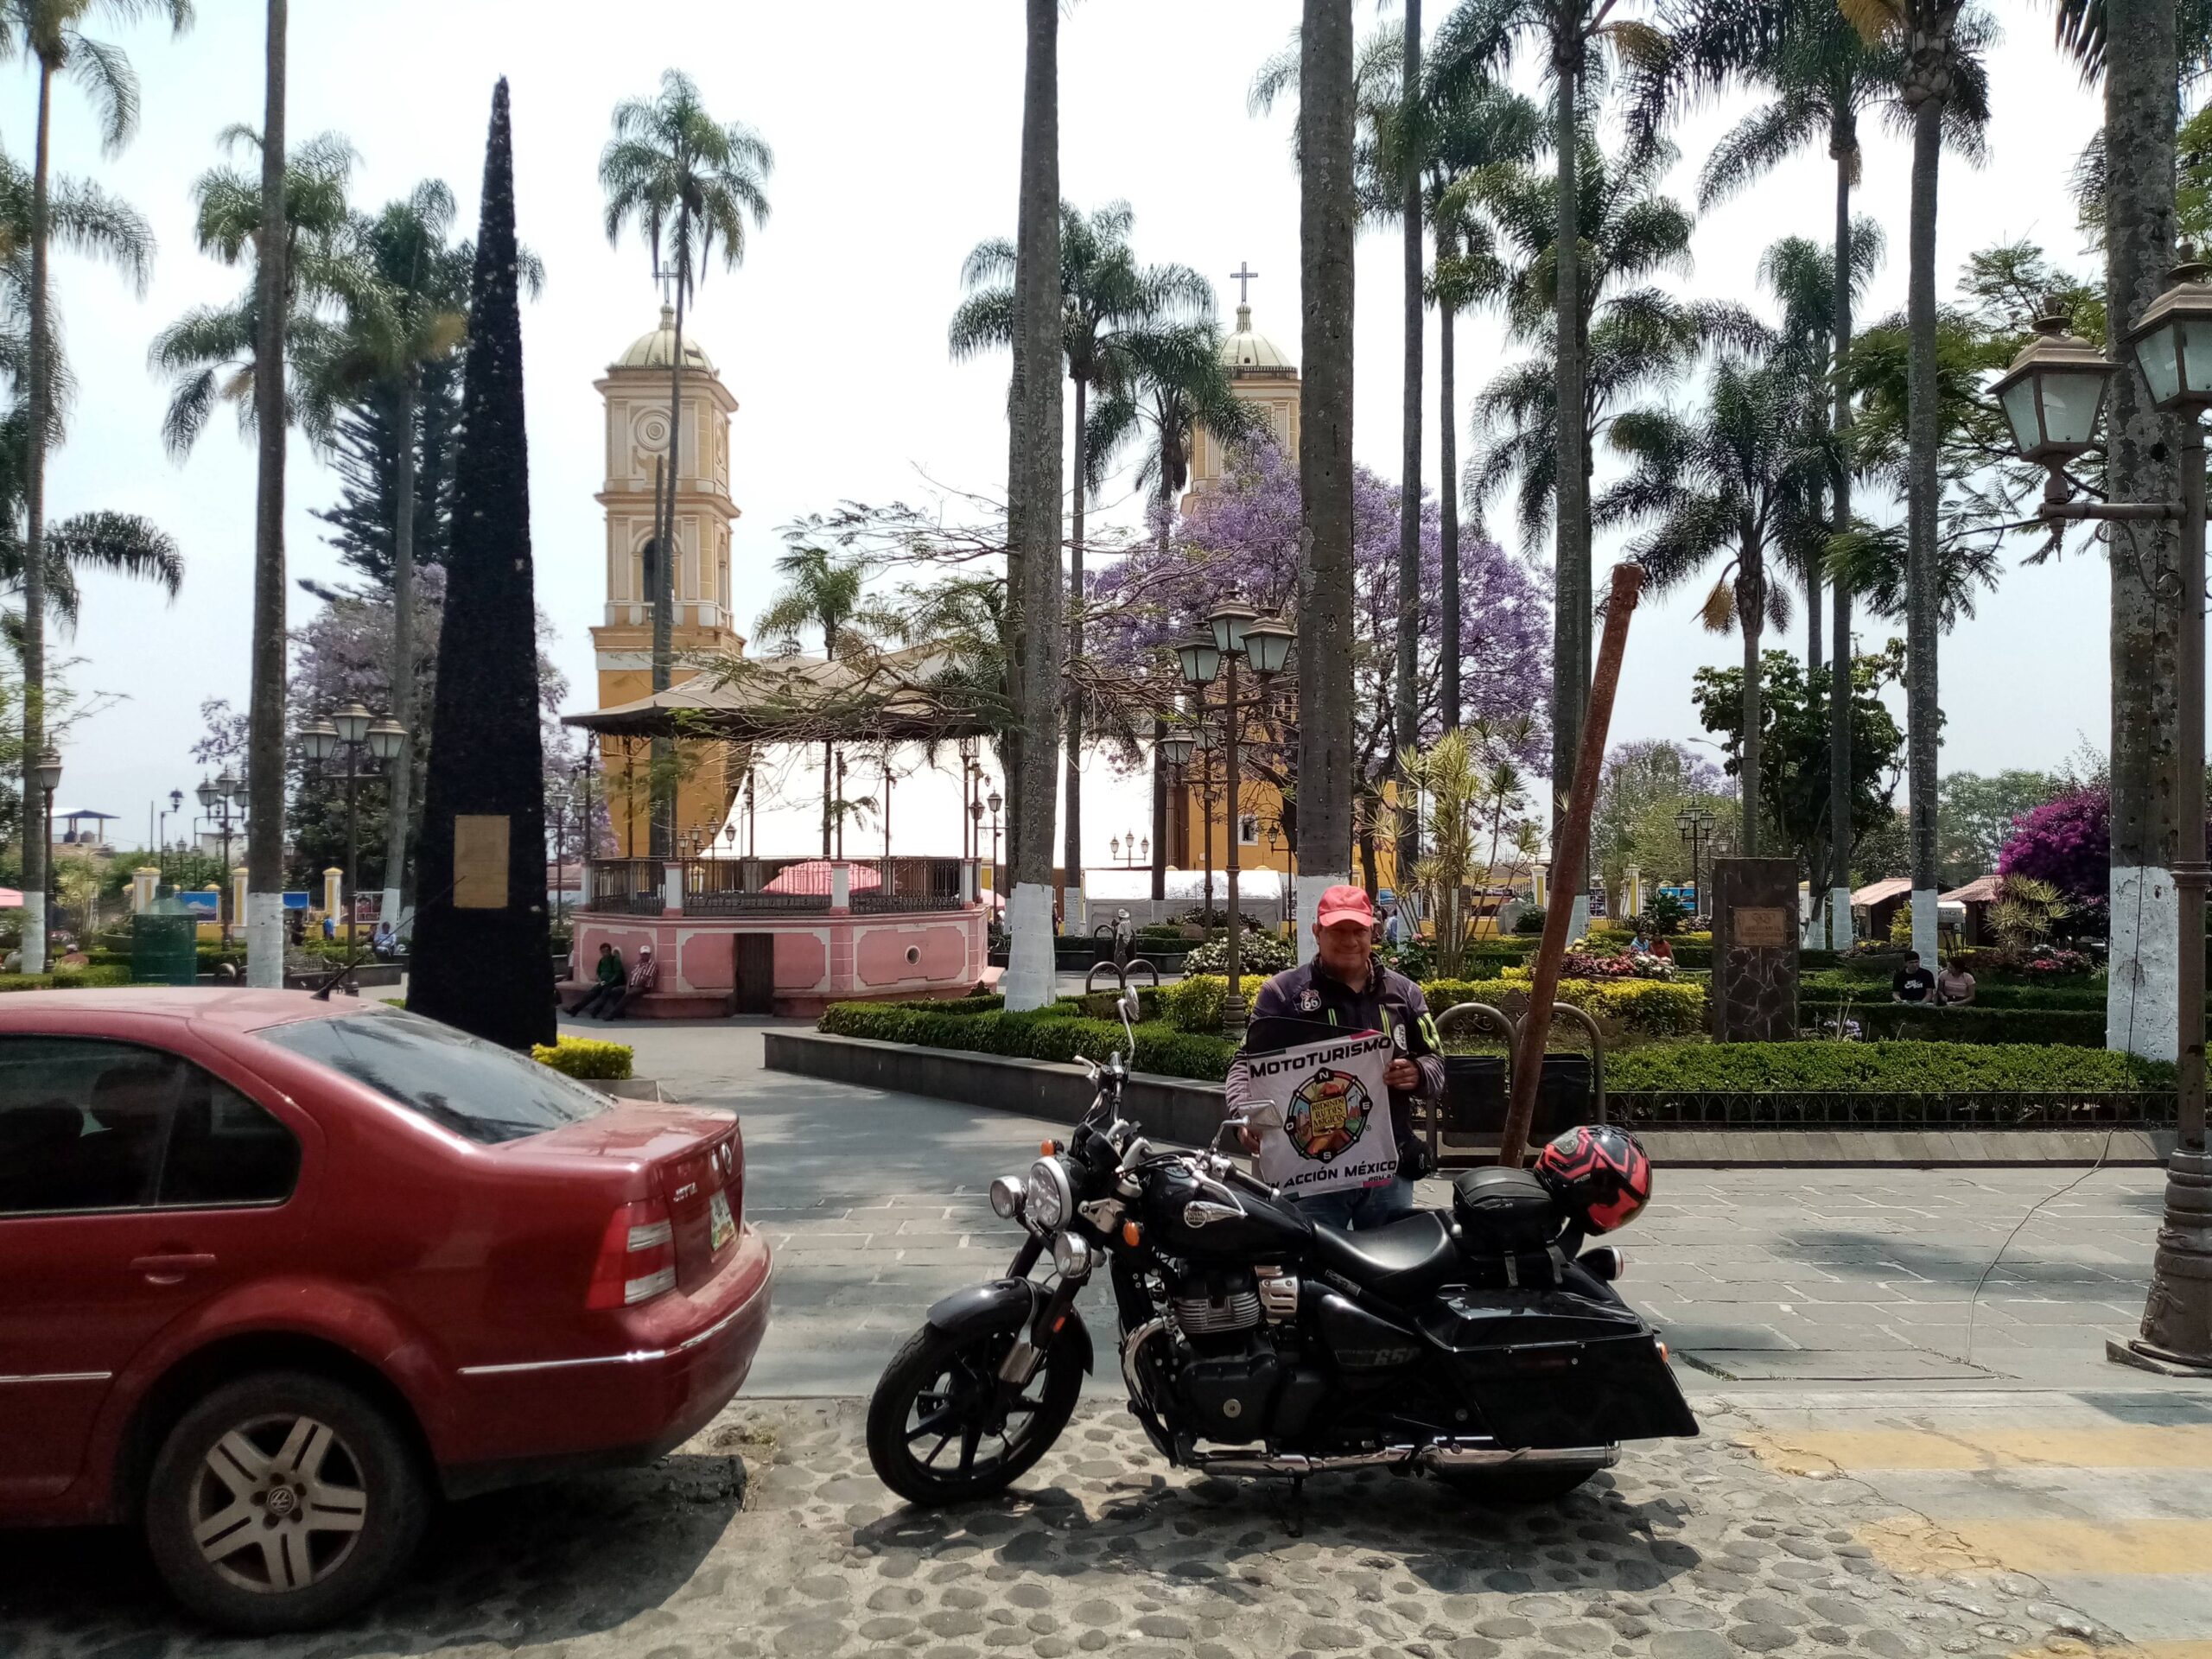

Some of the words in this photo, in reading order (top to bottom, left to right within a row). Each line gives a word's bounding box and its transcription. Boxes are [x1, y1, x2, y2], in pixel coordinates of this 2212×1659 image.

[1304, 997, 1319, 1009] 66
[1249, 1037, 1391, 1078] MOTOTURISMO
[1363, 1102, 1370, 1110] E
[1284, 1166, 1338, 1188] ACCIÓN
[1344, 1160, 1397, 1178] MÉXICO
